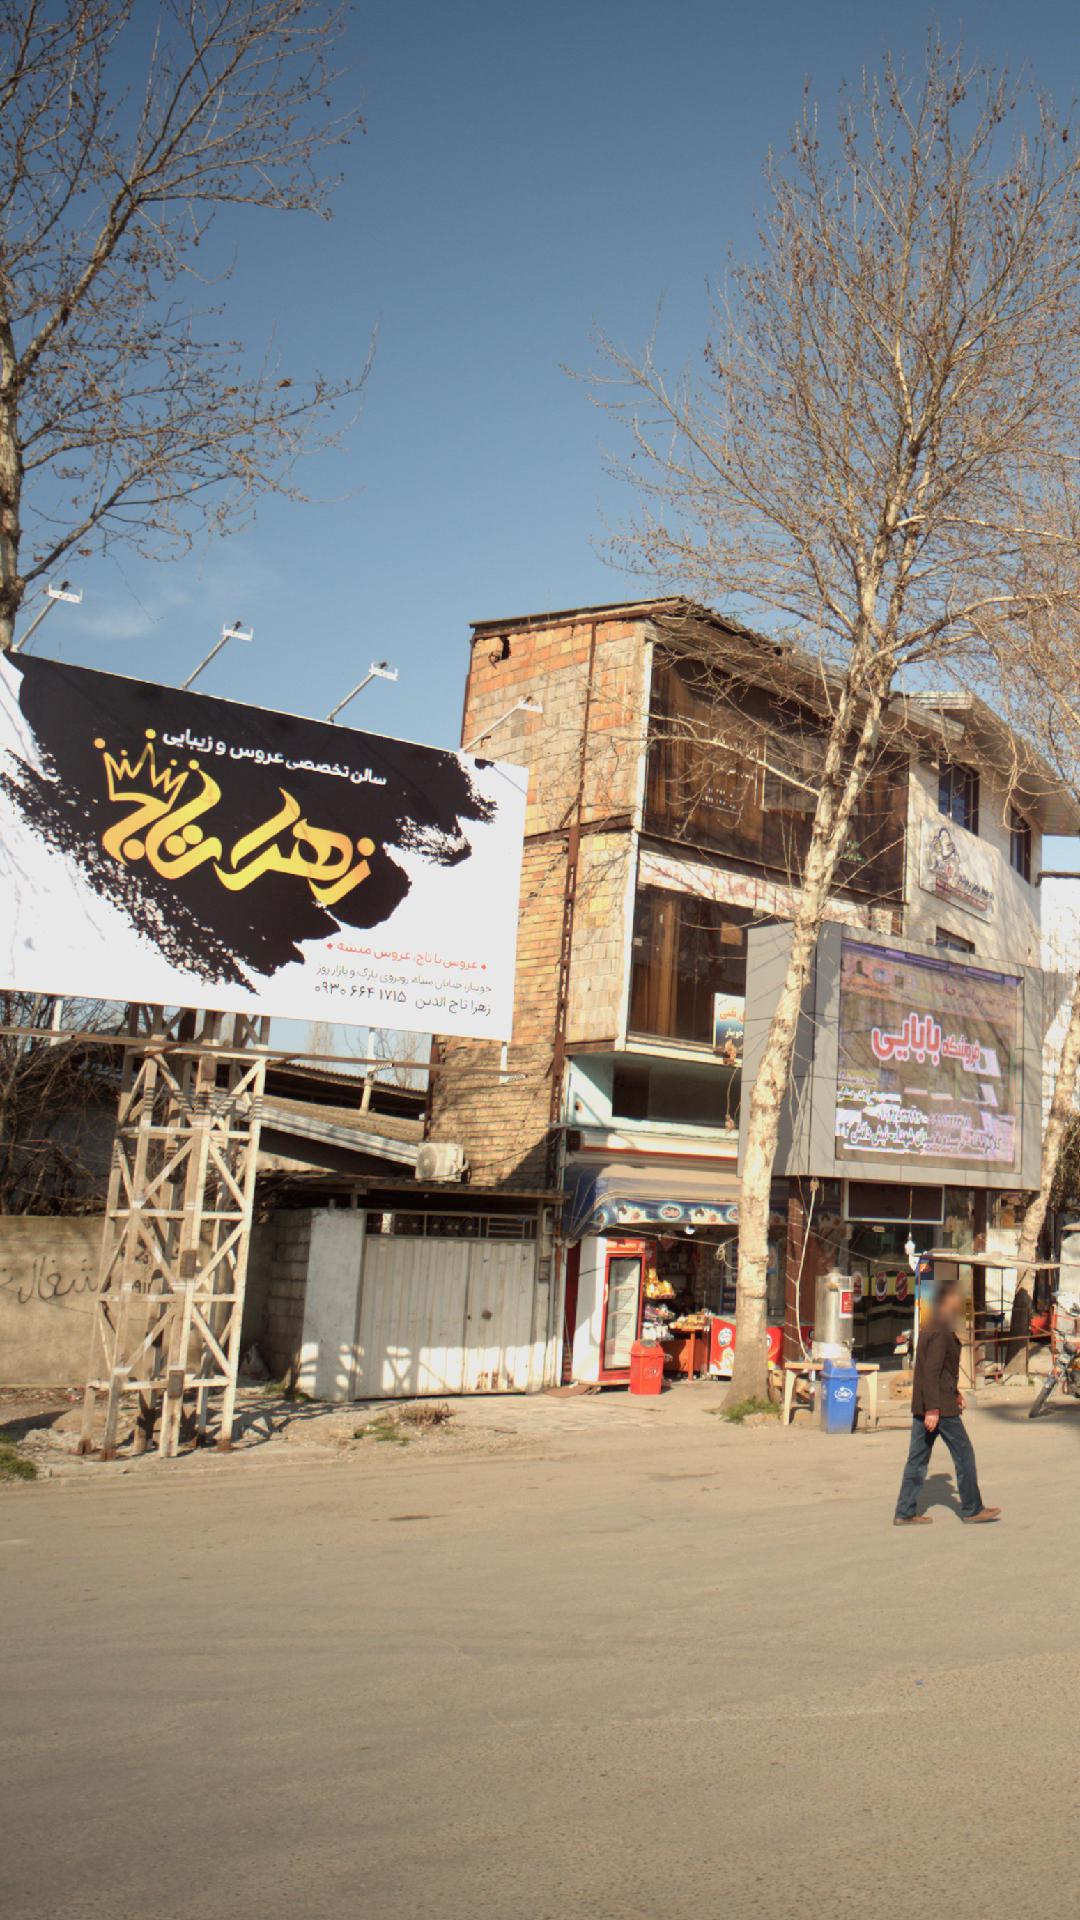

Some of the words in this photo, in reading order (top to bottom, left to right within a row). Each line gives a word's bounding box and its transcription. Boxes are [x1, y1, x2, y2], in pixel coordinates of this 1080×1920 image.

[162, 728, 213, 753] زیبایی
[215, 740, 227, 755] و
[229, 746, 284, 765] عروس
[285, 757, 349, 778] تخصصی
[350, 766, 387, 785] سالن
[101, 769, 222, 880] تاج
[213, 786, 376, 906] زهرا
[374, 950, 411, 962] عروس
[443, 958, 478, 970] عروس
[349, 969, 356, 979] و
[415, 995, 447, 1010] الدین
[448, 998, 468, 1014] تاج
[472, 1000, 491, 1016] زهرا
[872, 1012, 941, 1066] بابایی
